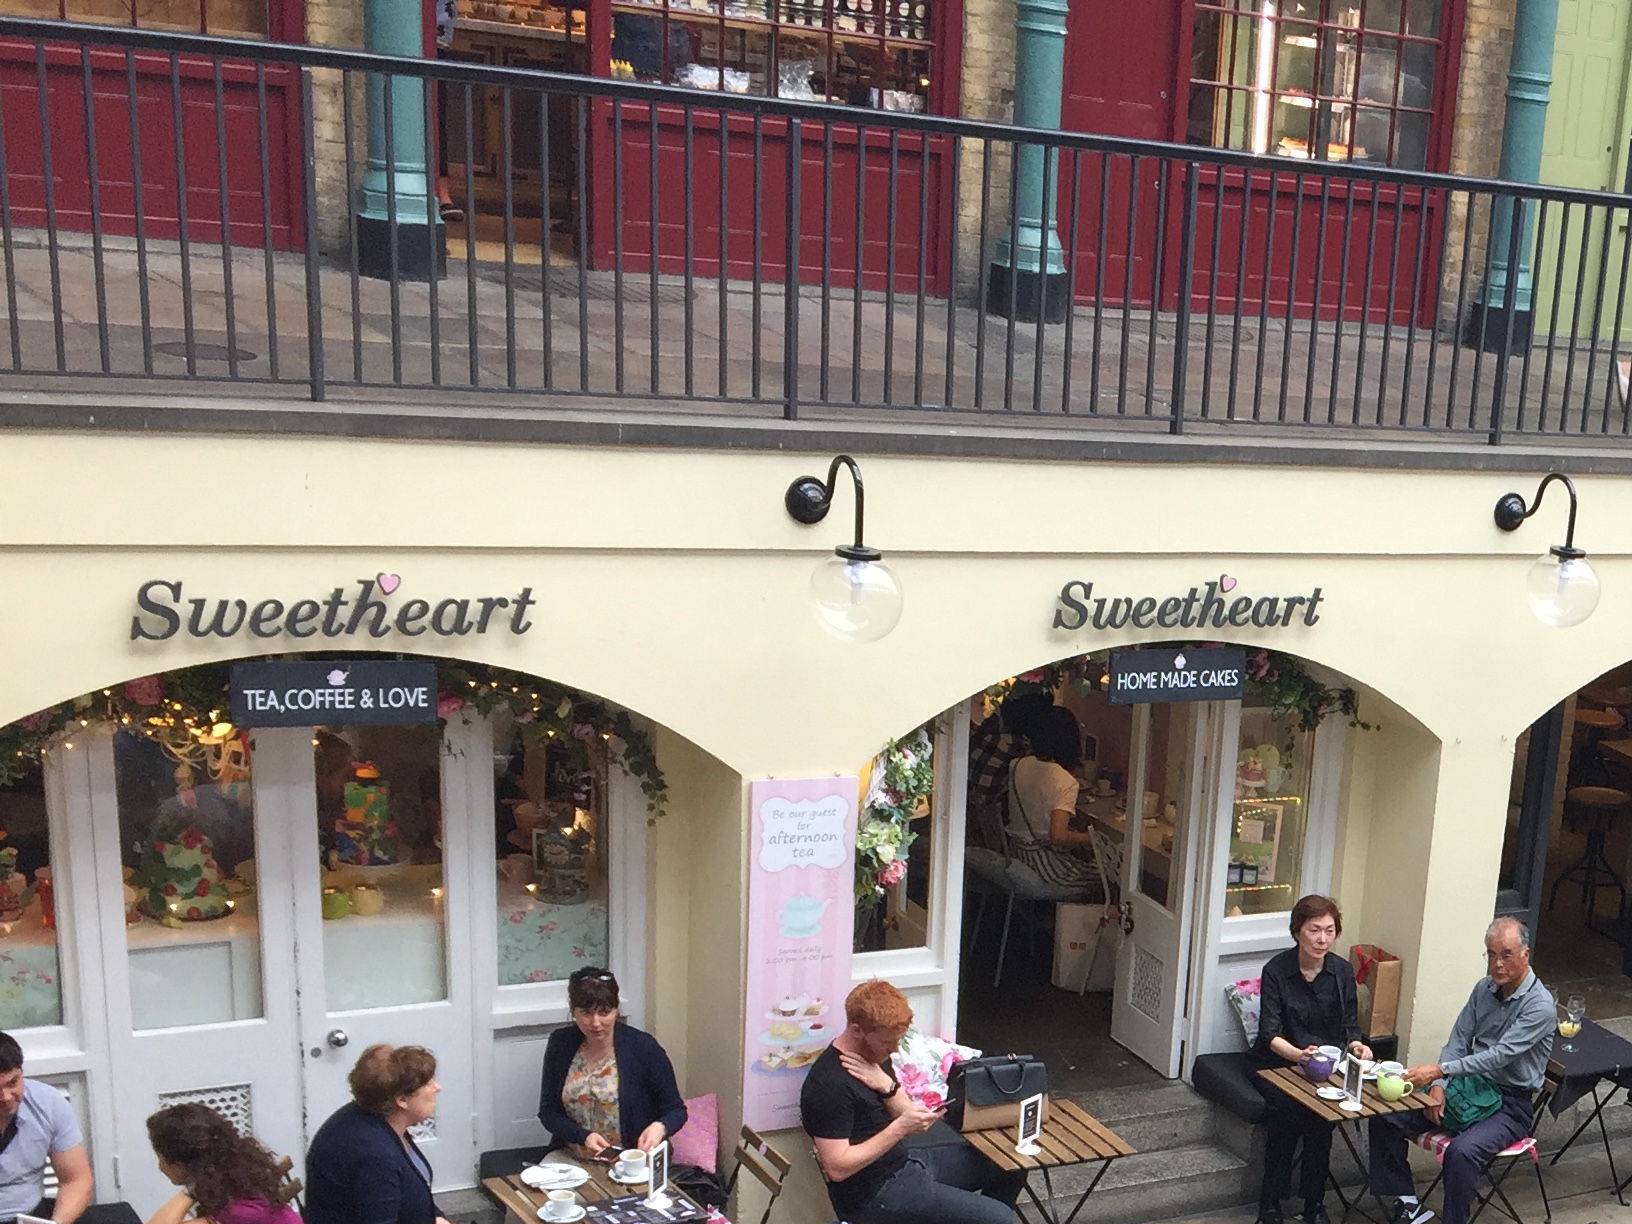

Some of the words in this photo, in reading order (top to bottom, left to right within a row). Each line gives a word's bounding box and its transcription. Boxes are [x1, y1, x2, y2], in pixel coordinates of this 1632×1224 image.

[131, 577, 536, 640] Sweetheart
[1052, 579, 1325, 630] Sweetheart
[1117, 672, 1158, 691] HOME
[1160, 670, 1197, 689] MADE
[1200, 669, 1239, 687] CAKES
[360, 690, 375, 709] &
[379, 688, 429, 709] LOVE
[772, 809, 785, 819] Be
[789, 810, 807, 818] our
[810, 808, 837, 820] guest
[797, 821, 812, 830] for
[768, 831, 838, 844] afternoon
[792, 847, 814, 858] tea
